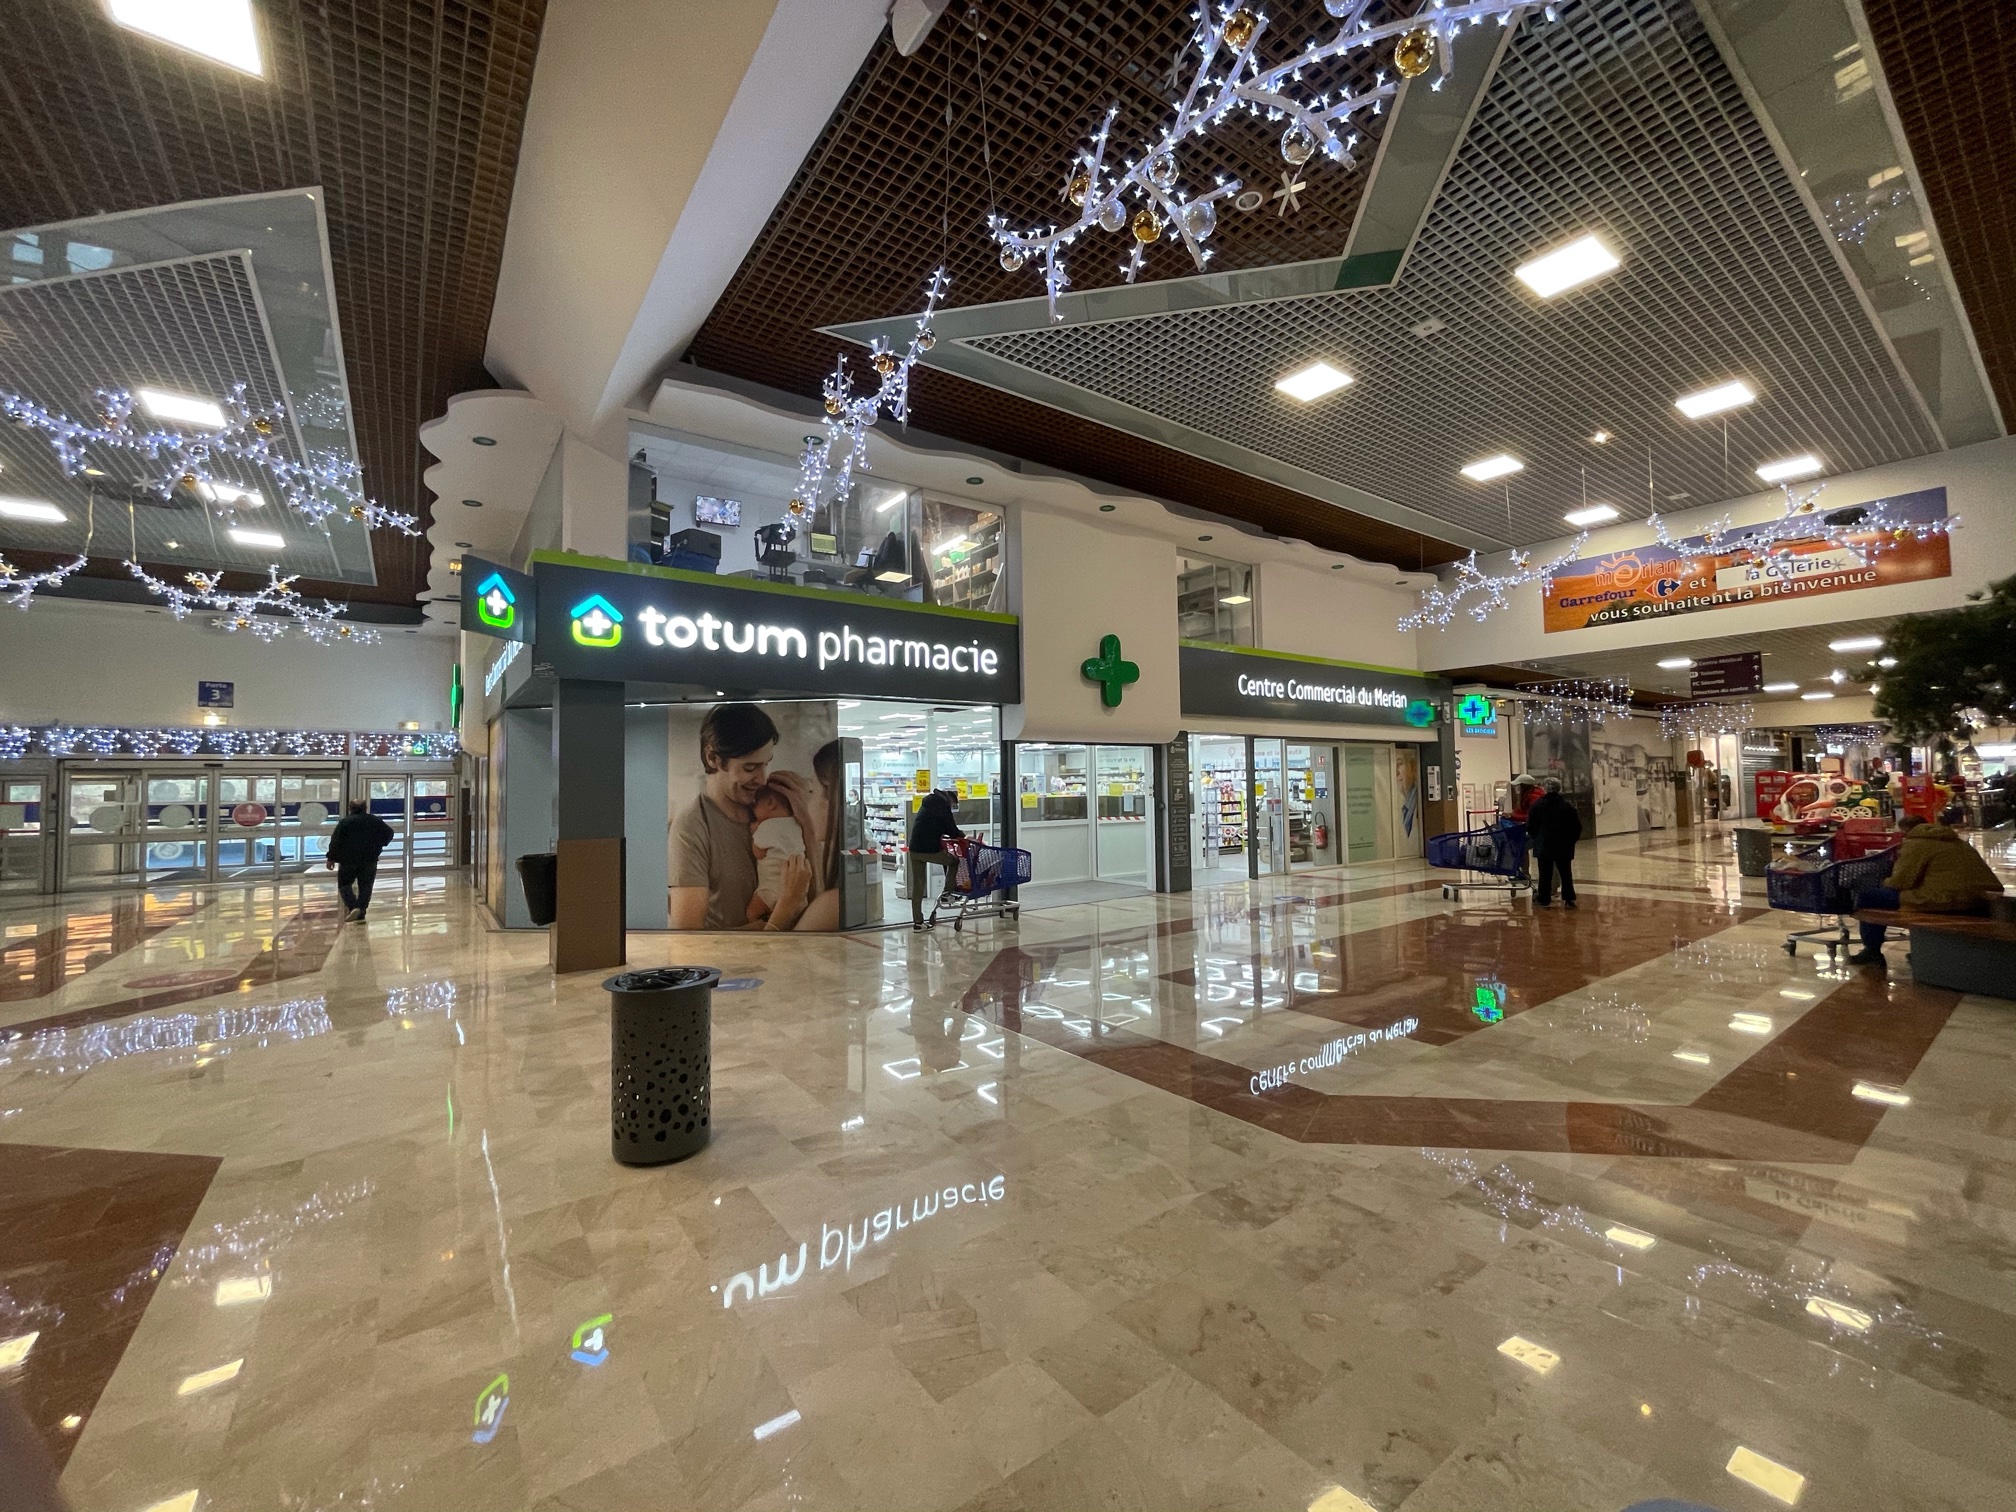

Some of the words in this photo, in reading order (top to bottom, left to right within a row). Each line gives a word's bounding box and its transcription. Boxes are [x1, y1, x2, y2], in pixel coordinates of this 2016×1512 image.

[1590, 607, 1628, 622] vous
[1633, 590, 1732, 616] souhaitent
[1737, 587, 1754, 601] la
[1760, 570, 1877, 598] bienvenue
[1689, 576, 1707, 590] et
[1559, 588, 1638, 609] Carrefour
[637, 605, 808, 659] totum
[818, 624, 999, 675] pharmacie
[211, 689, 220, 700] 3
[1237, 674, 1285, 698] Centre
[1287, 679, 1356, 704] Commercial
[1358, 686, 1372, 706] du
[1374, 688, 1408, 708] Merlan
